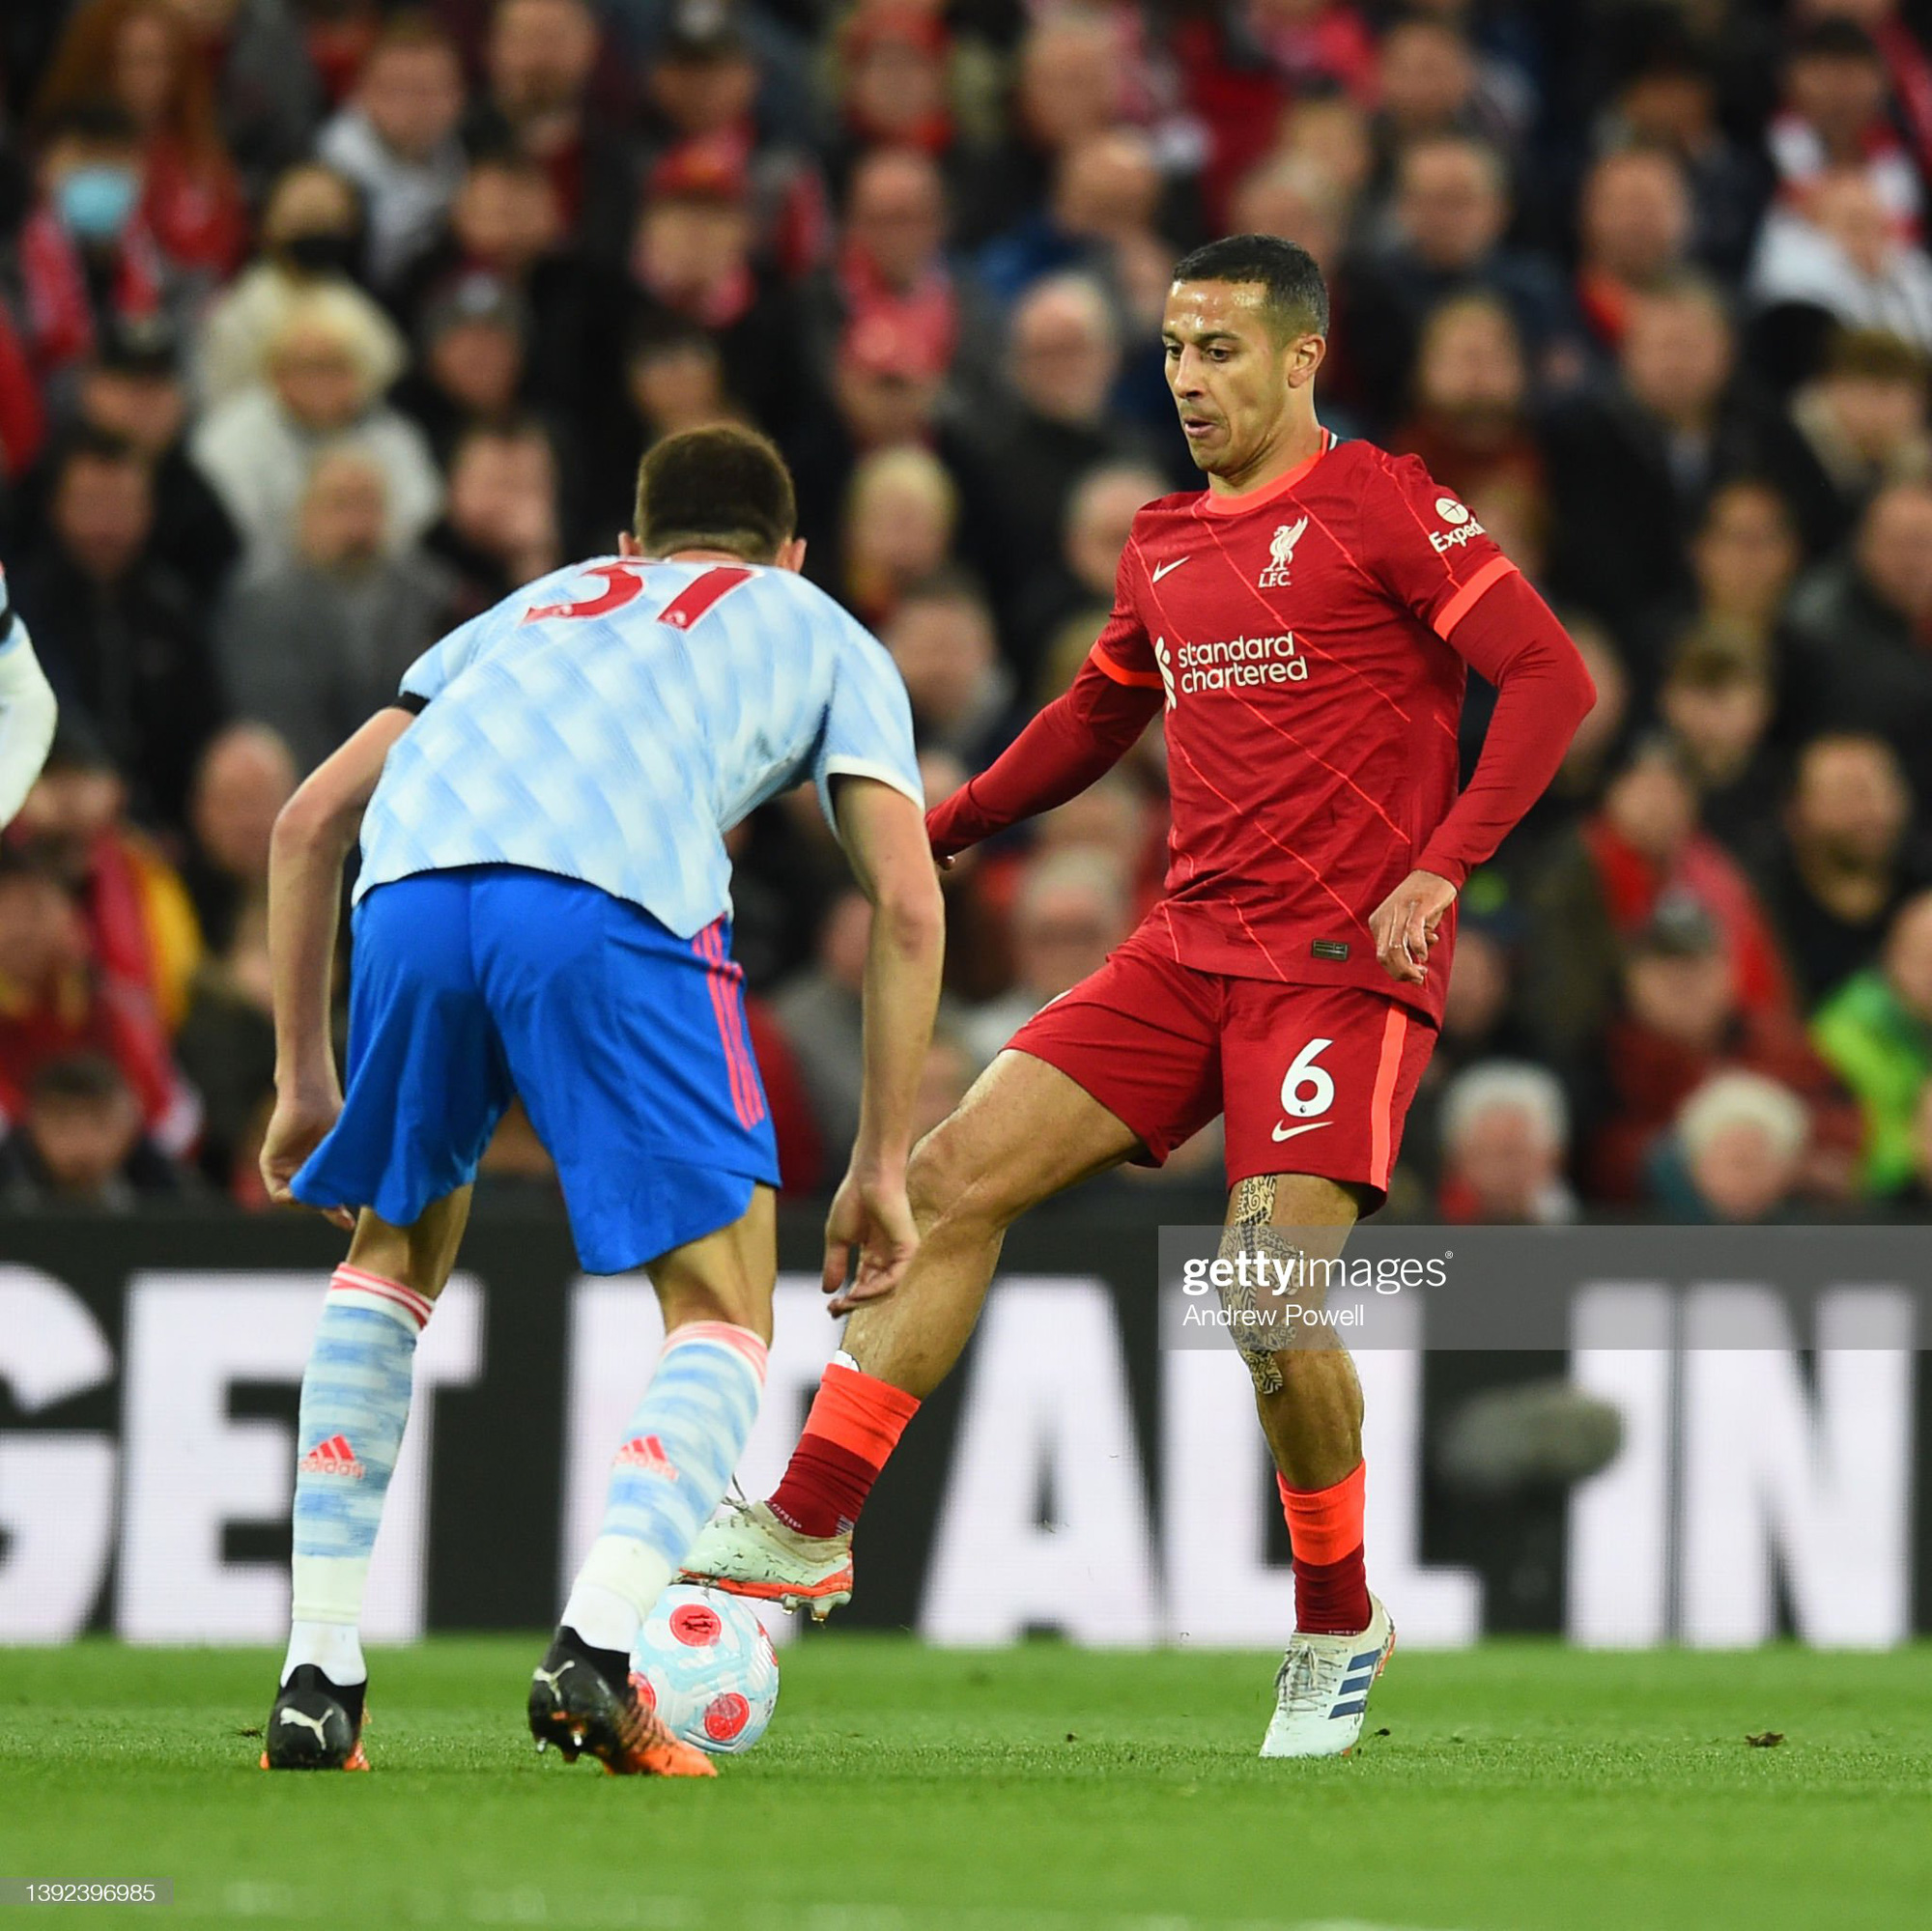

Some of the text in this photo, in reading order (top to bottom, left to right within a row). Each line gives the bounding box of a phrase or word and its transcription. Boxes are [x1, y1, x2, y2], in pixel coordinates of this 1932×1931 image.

[1178, 631, 1294, 668] standard
[1181, 655, 1308, 694] chartered
[1281, 1038, 1335, 1118] 6
[916, 1273, 1486, 1650] ALL
[1562, 1280, 1918, 1653] IN
